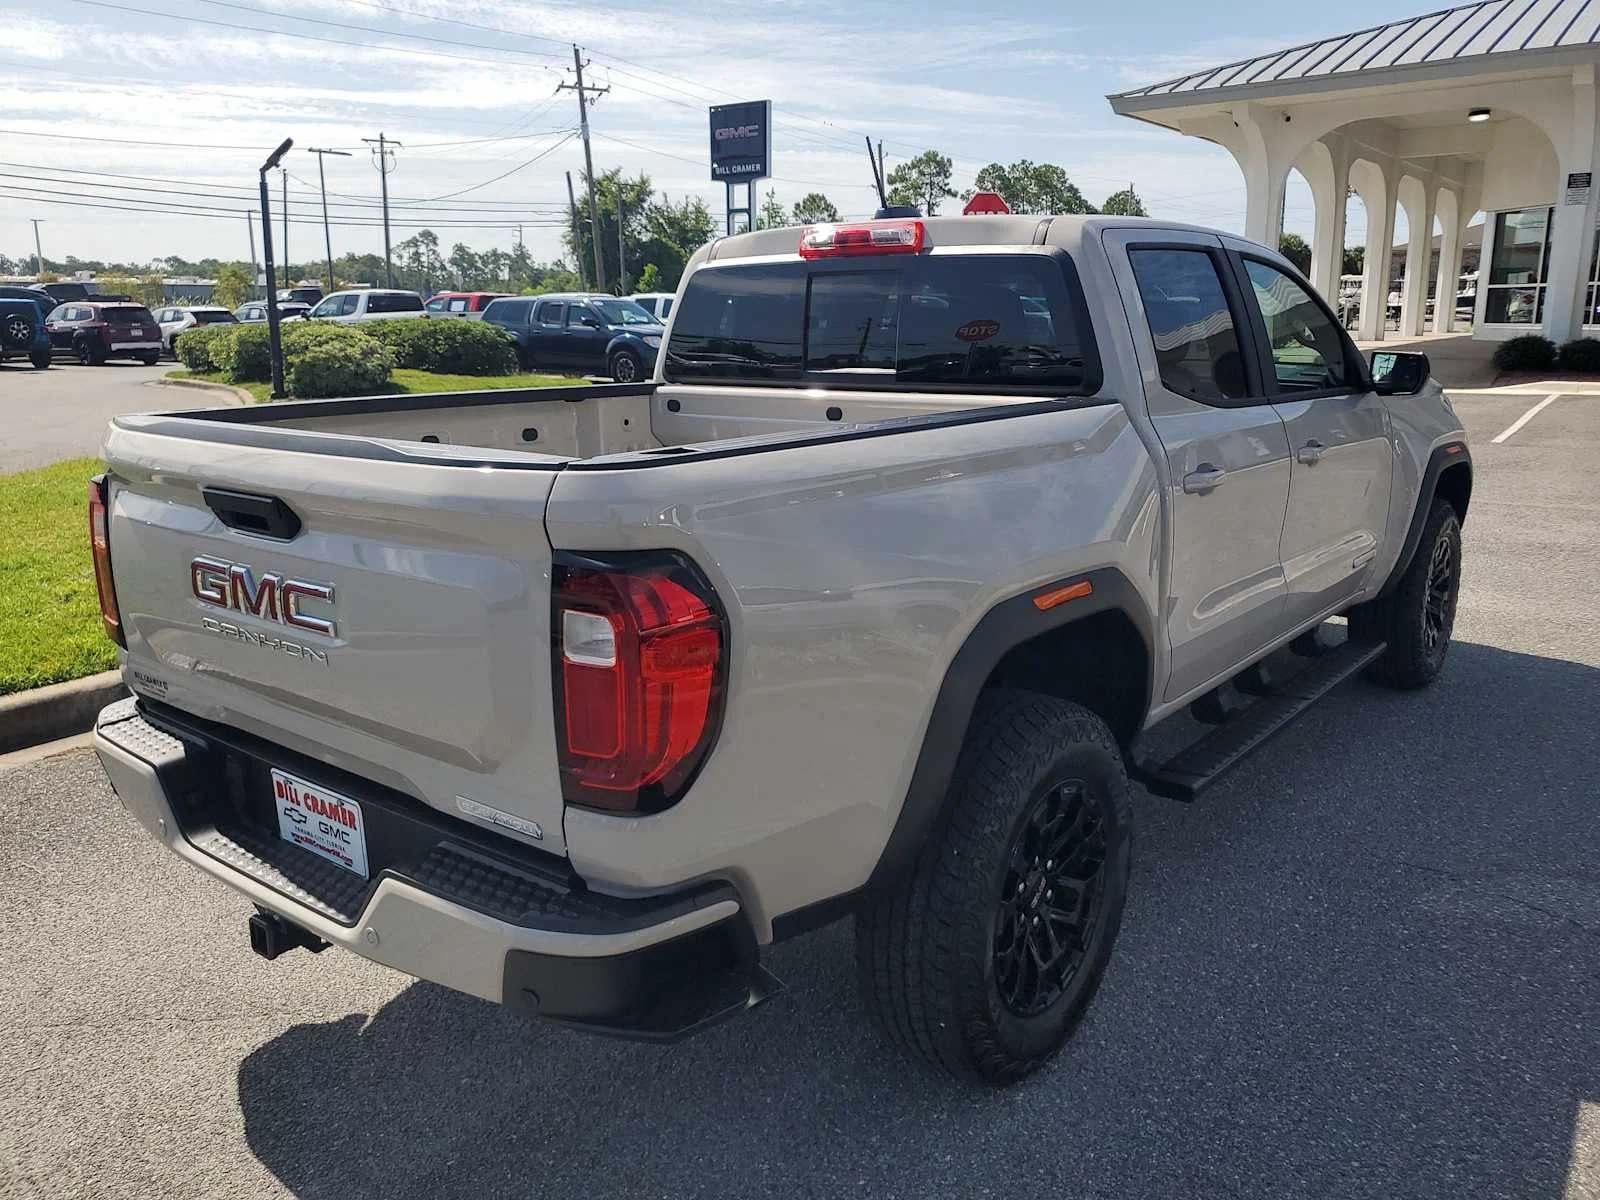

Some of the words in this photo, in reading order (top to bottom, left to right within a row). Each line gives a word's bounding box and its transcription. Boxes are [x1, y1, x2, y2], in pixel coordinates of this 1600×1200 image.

[715, 124, 759, 140] GMC
[715, 166, 730, 174] BILL
[732, 163, 761, 173] CRAMER
[191, 554, 337, 637] GMC
[201, 617, 329, 665] CANYON
[276, 781, 300, 806] BILL
[303, 792, 357, 831] CRAMER
[318, 821, 351, 845] GMC
